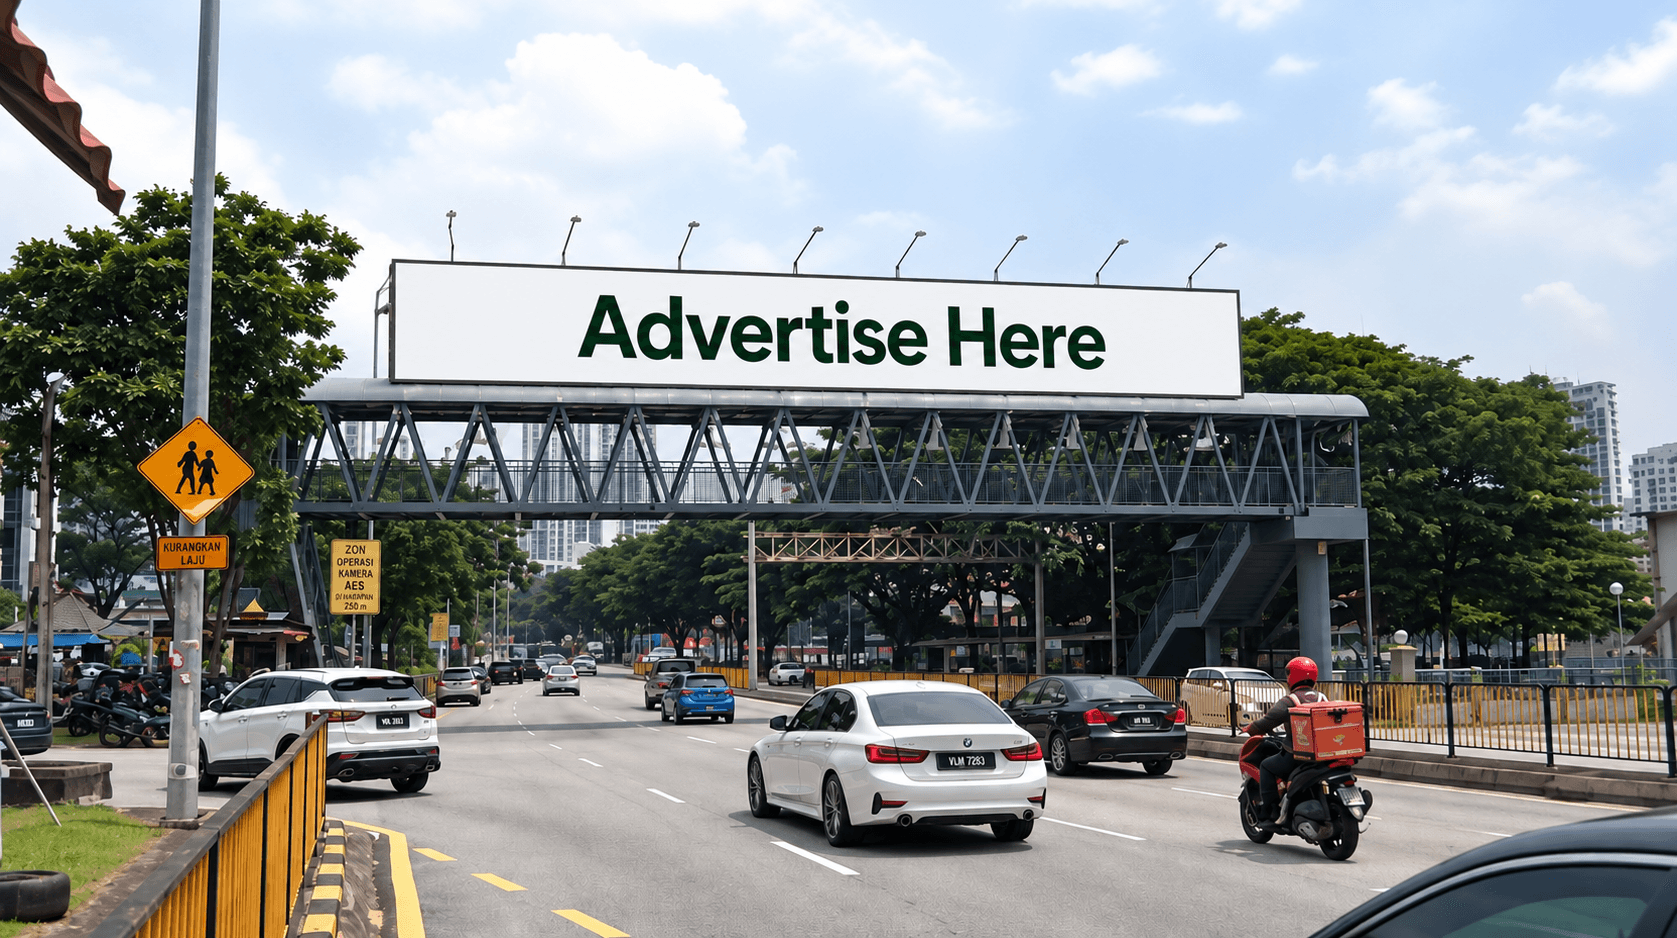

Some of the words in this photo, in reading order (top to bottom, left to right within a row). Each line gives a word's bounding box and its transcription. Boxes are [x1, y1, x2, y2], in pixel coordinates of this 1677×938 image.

[577, 294, 929, 366] Advertise
[946, 305, 1107, 371] Here
[163, 541, 221, 553] KURANGKAN
[345, 544, 366, 555] ZON
[180, 554, 205, 566] LAJU
[336, 557, 374, 567] OPERASI
[338, 569, 374, 578] KAMERA
[344, 580, 365, 591] AES
[344, 602, 359, 610] 250
